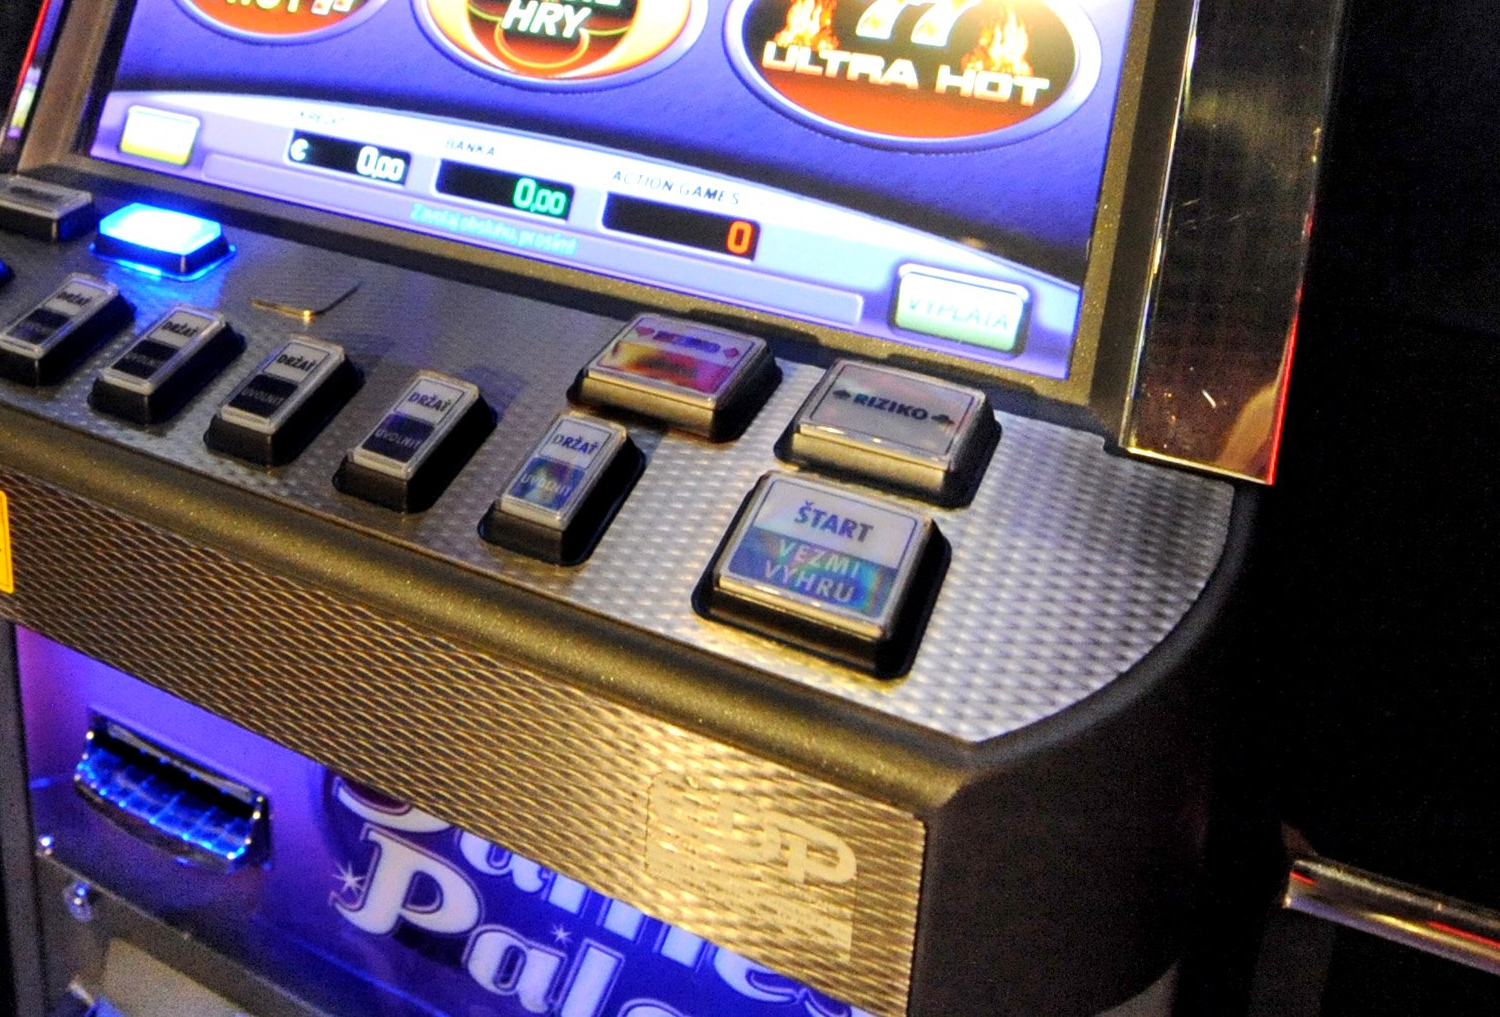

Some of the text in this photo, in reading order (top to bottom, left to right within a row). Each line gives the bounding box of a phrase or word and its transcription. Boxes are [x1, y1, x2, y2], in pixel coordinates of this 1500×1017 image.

[762, 41, 1050, 106] ULTRA HOT
[612, 170, 740, 205] ACTION GAMES
[727, 219, 754, 255] 0
[853, 393, 928, 420] RIZIKO
[794, 500, 874, 542] ŠTART
[779, 539, 861, 578] VEZMI
